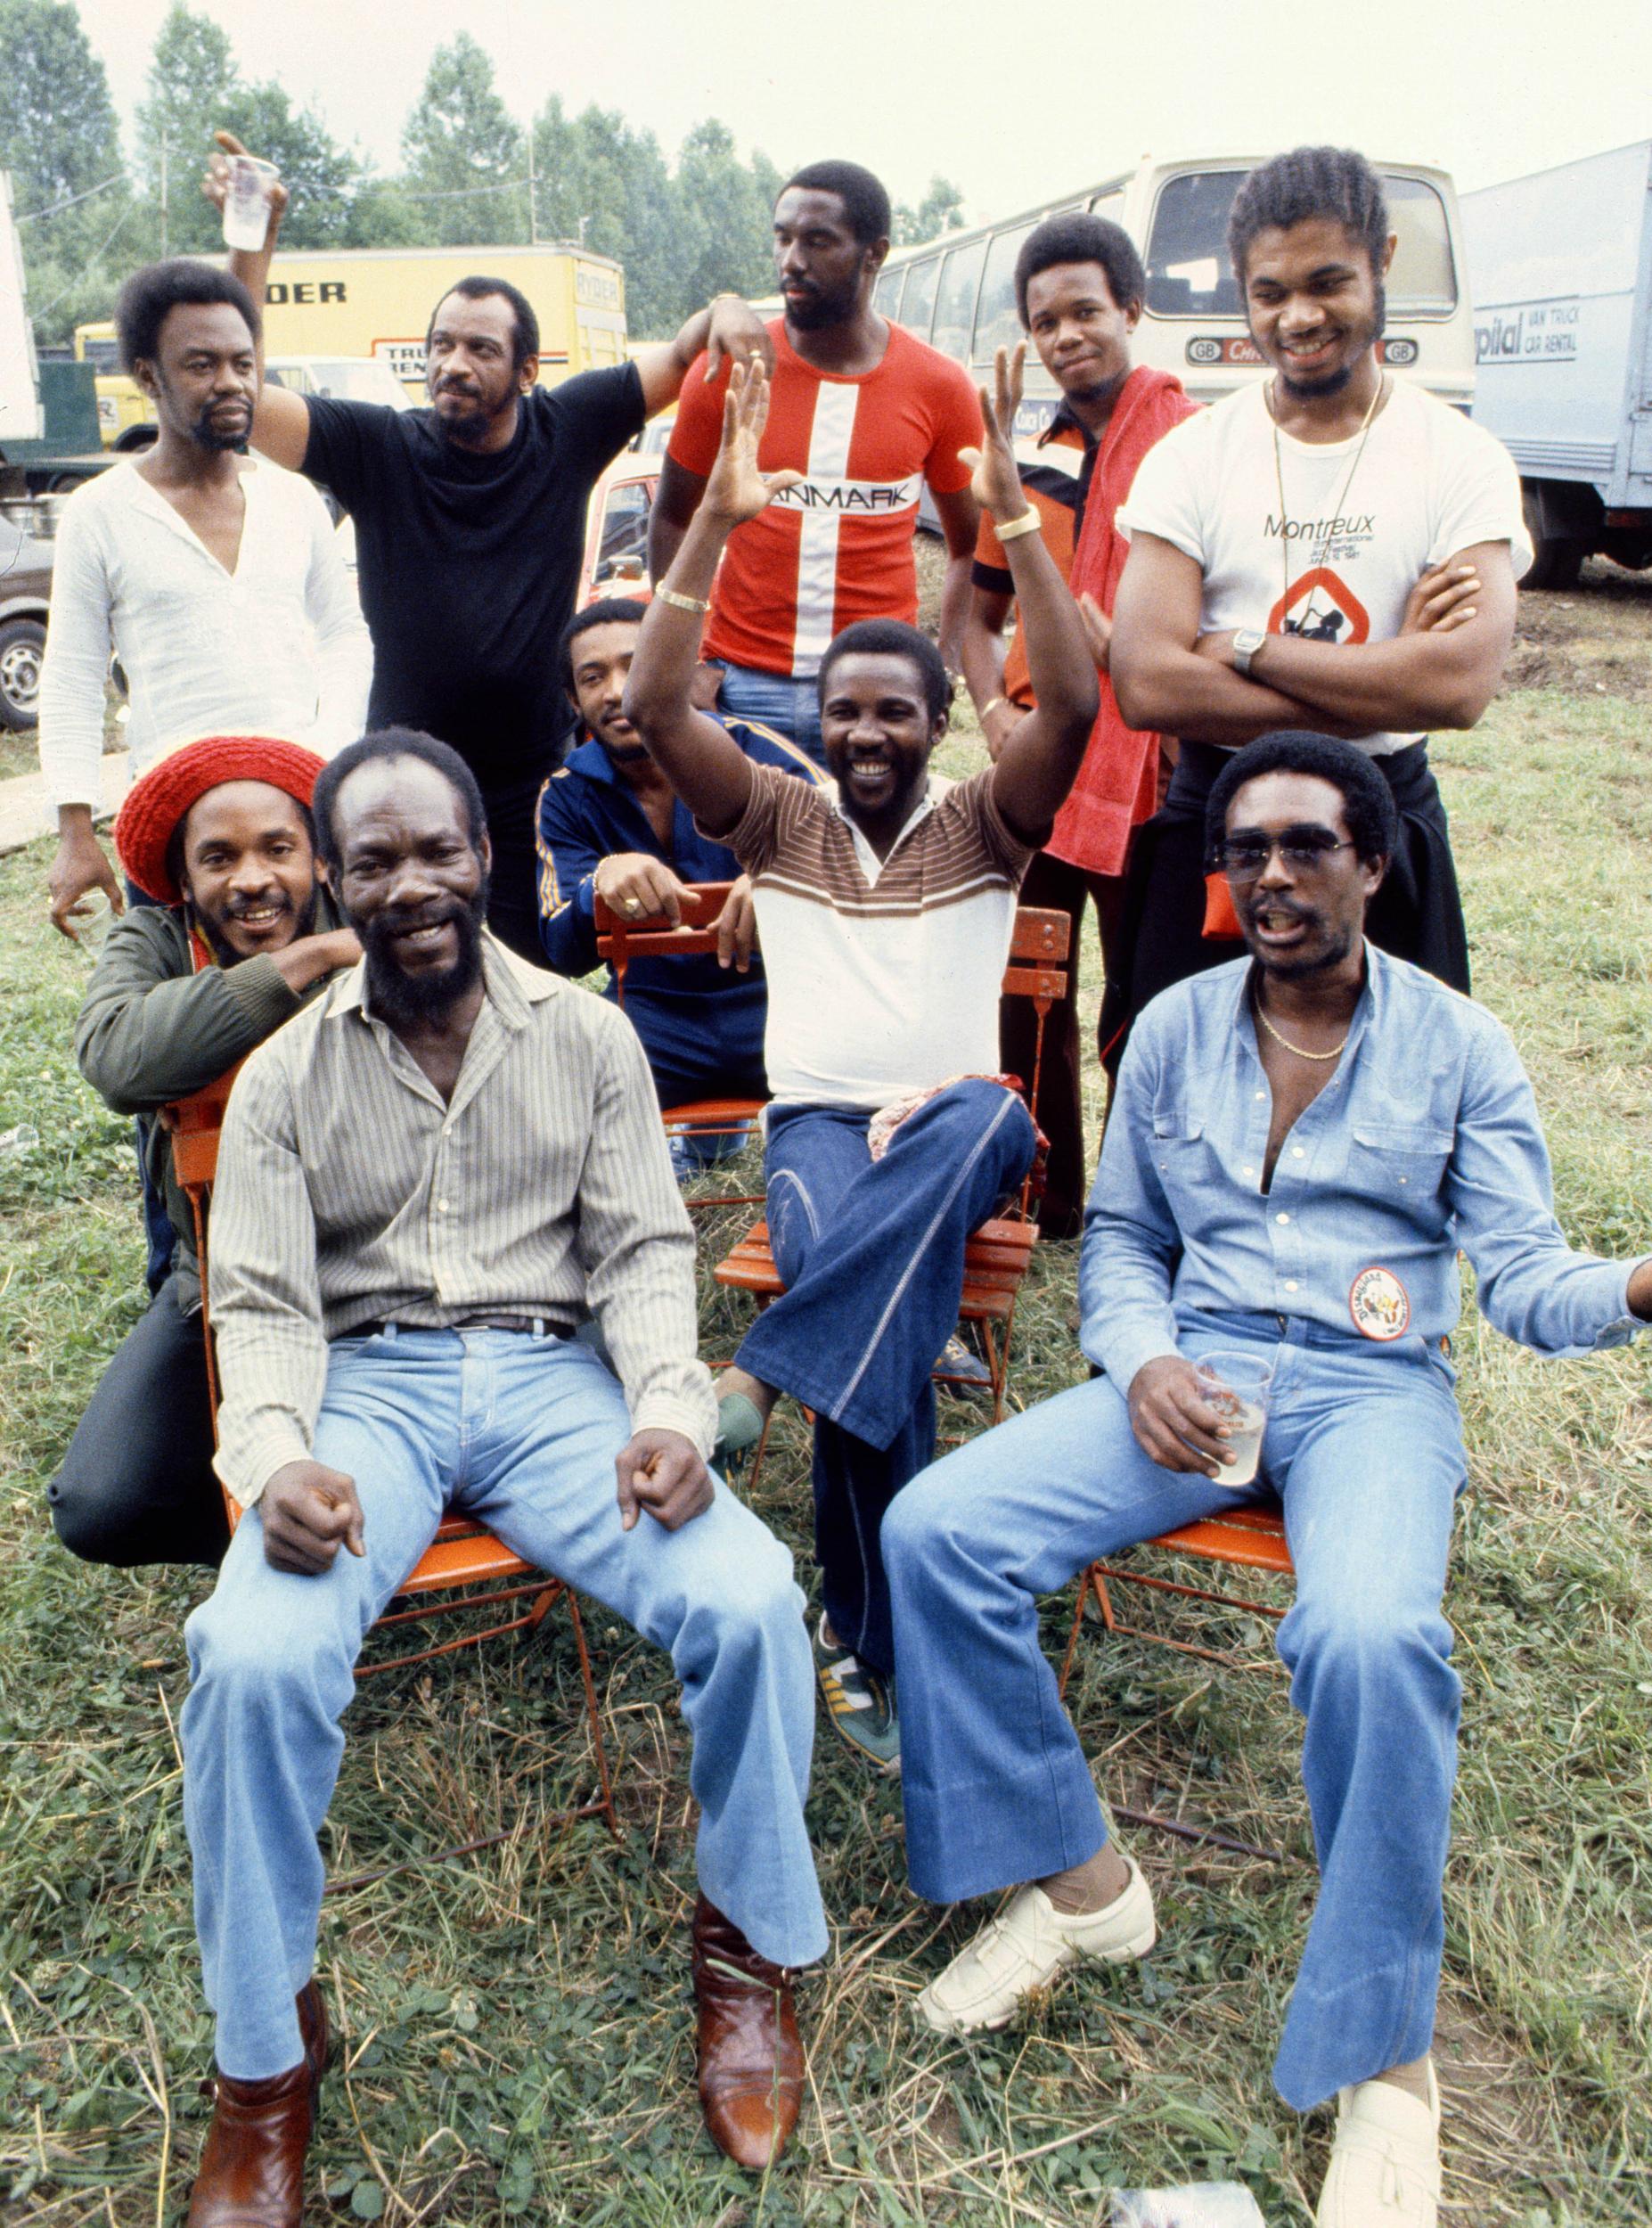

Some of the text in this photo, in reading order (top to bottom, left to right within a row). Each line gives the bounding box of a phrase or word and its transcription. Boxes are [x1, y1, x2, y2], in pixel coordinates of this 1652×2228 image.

[266, 283, 346, 304] DER
[1551, 306, 1580, 324] TRUCK
[1474, 312, 1523, 365] pital
[1525, 333, 1577, 354] CAR RENTAL
[385, 348, 428, 359] TRU
[1195, 343, 1214, 358] GB
[1391, 344, 1409, 359] GB
[1264, 514, 1376, 540] Montreux
